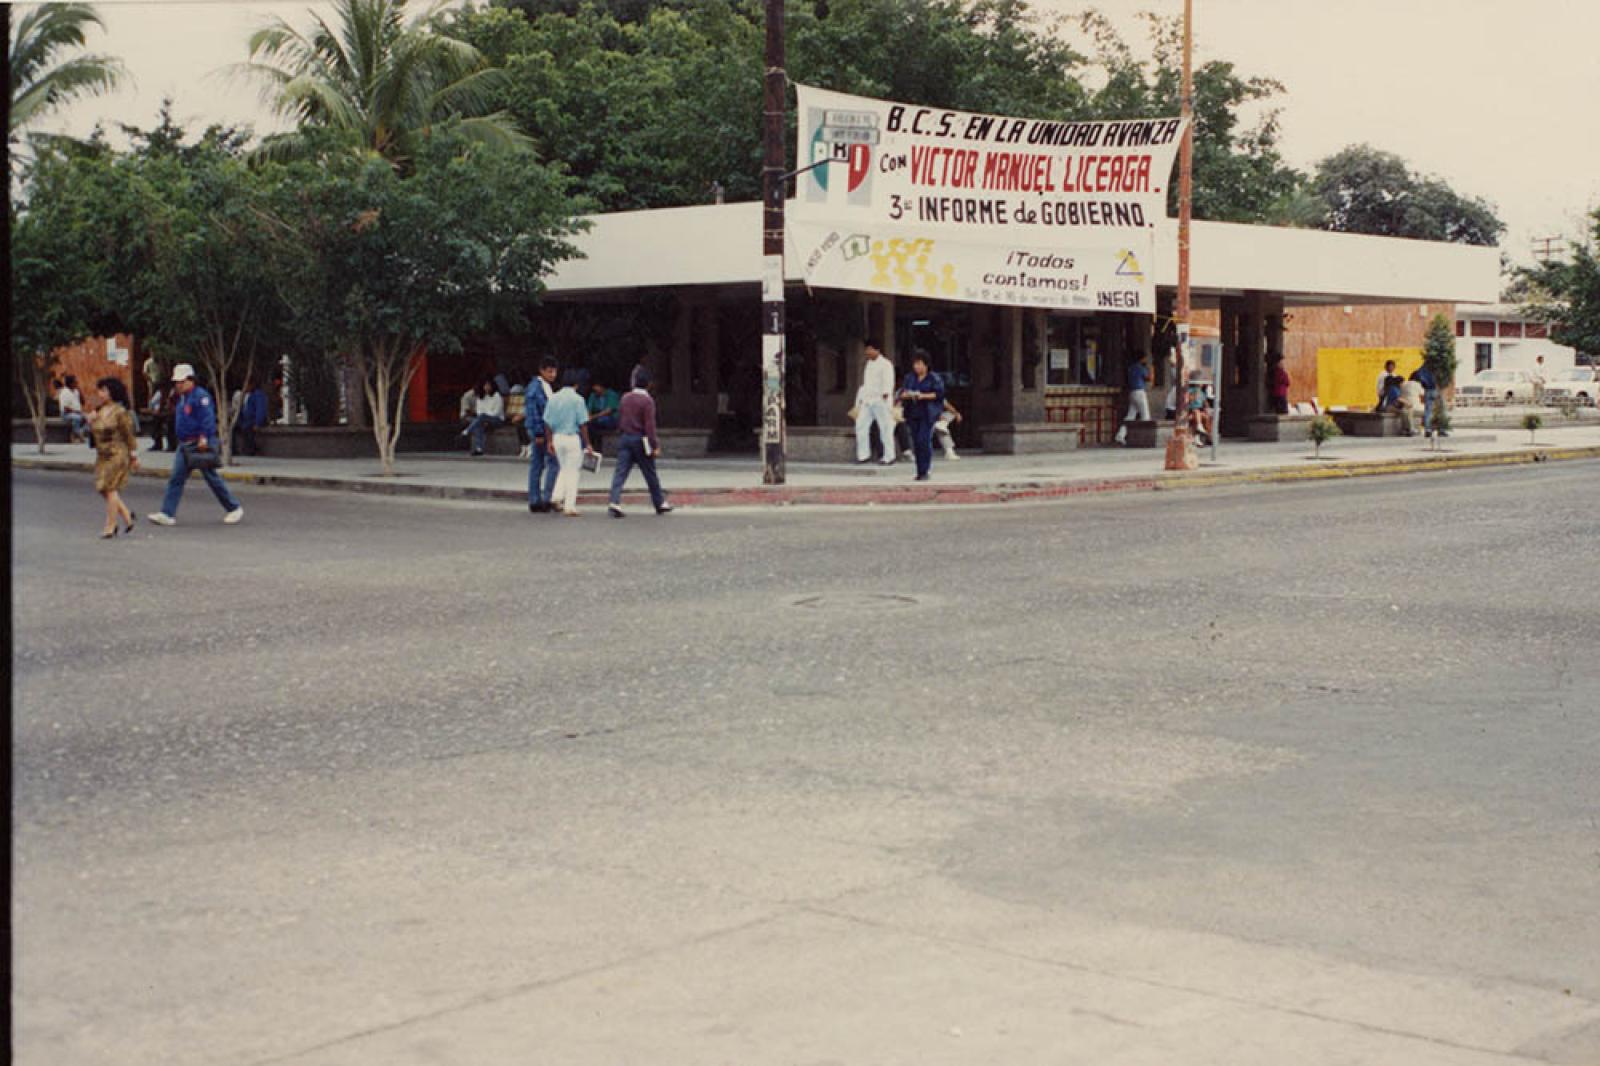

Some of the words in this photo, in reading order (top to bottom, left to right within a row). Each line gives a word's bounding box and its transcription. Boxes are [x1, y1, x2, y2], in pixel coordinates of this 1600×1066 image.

[963, 116, 995, 141] EN
[995, 119, 1027, 143] LA
[1027, 121, 1104, 147] UNIDAD
[1102, 119, 1181, 147] AVANZA
[911, 145, 980, 189] VICTOR
[982, 151, 1055, 192] MANUEL
[1063, 154, 1161, 193] LICEAGA.
[919, 196, 1008, 224] INFORME
[1013, 200, 1037, 225] de
[1041, 200, 1154, 228] GOBIERNO.
[983, 271, 1089, 291] contamos!
[1096, 290, 1140, 308] INEGI
